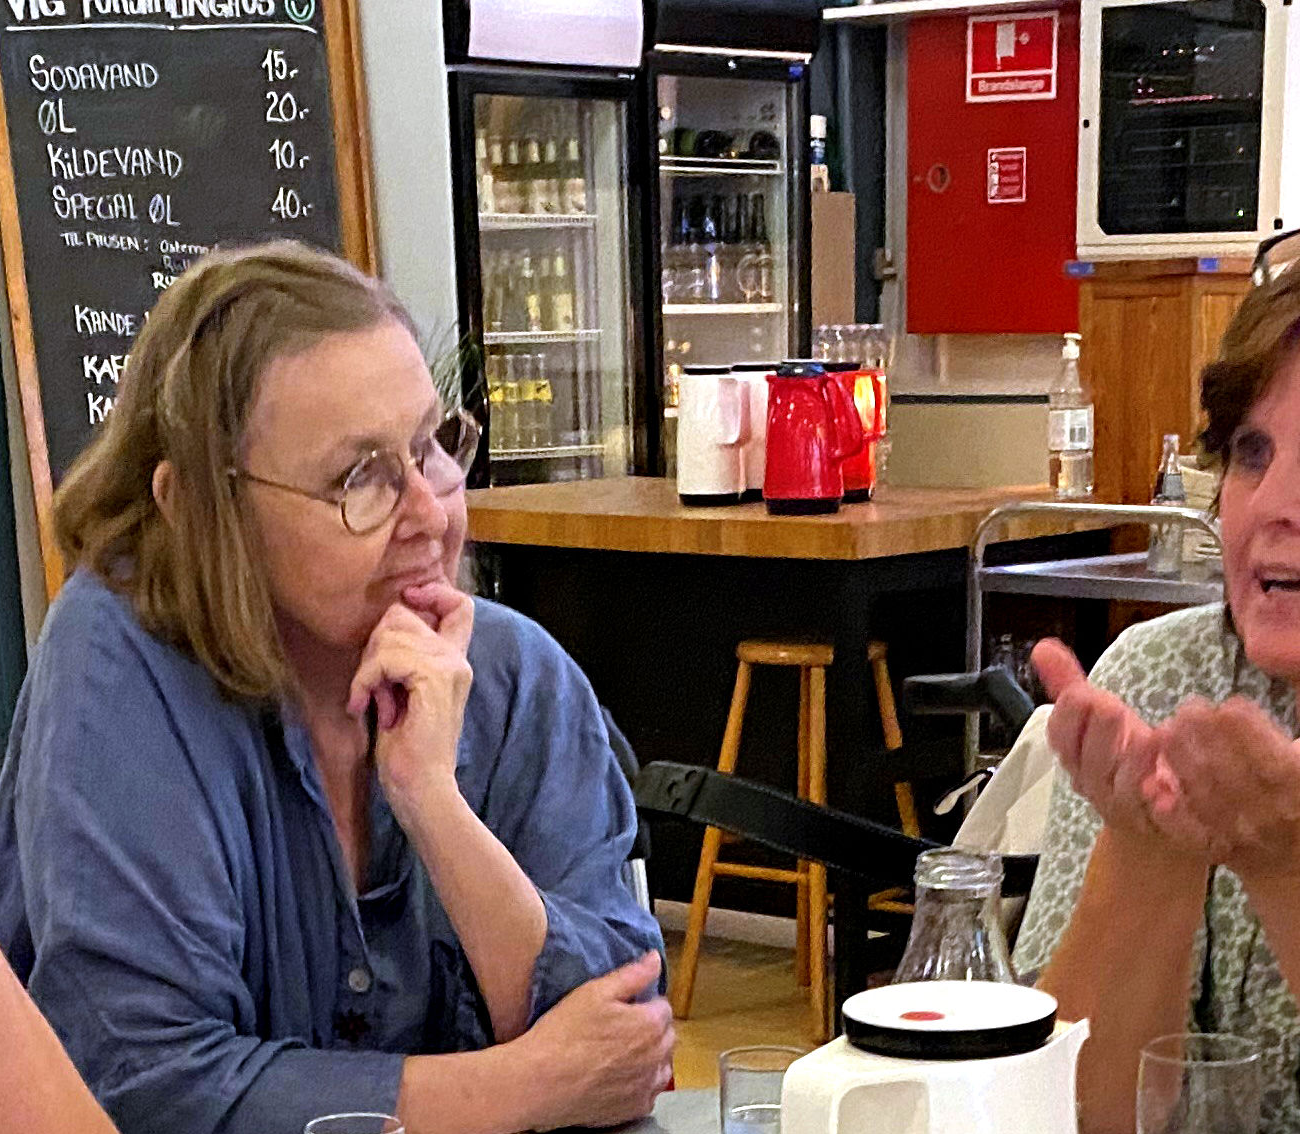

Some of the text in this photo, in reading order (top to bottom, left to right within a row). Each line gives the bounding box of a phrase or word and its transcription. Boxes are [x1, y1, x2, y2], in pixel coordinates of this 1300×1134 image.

[29, 54, 159, 91] SODAVAND
[38, 98, 77, 134] ØL
[149, 193, 181, 226] ØL
[60, 231, 84, 247] TIL
[74, 304, 136, 337] KANDE
